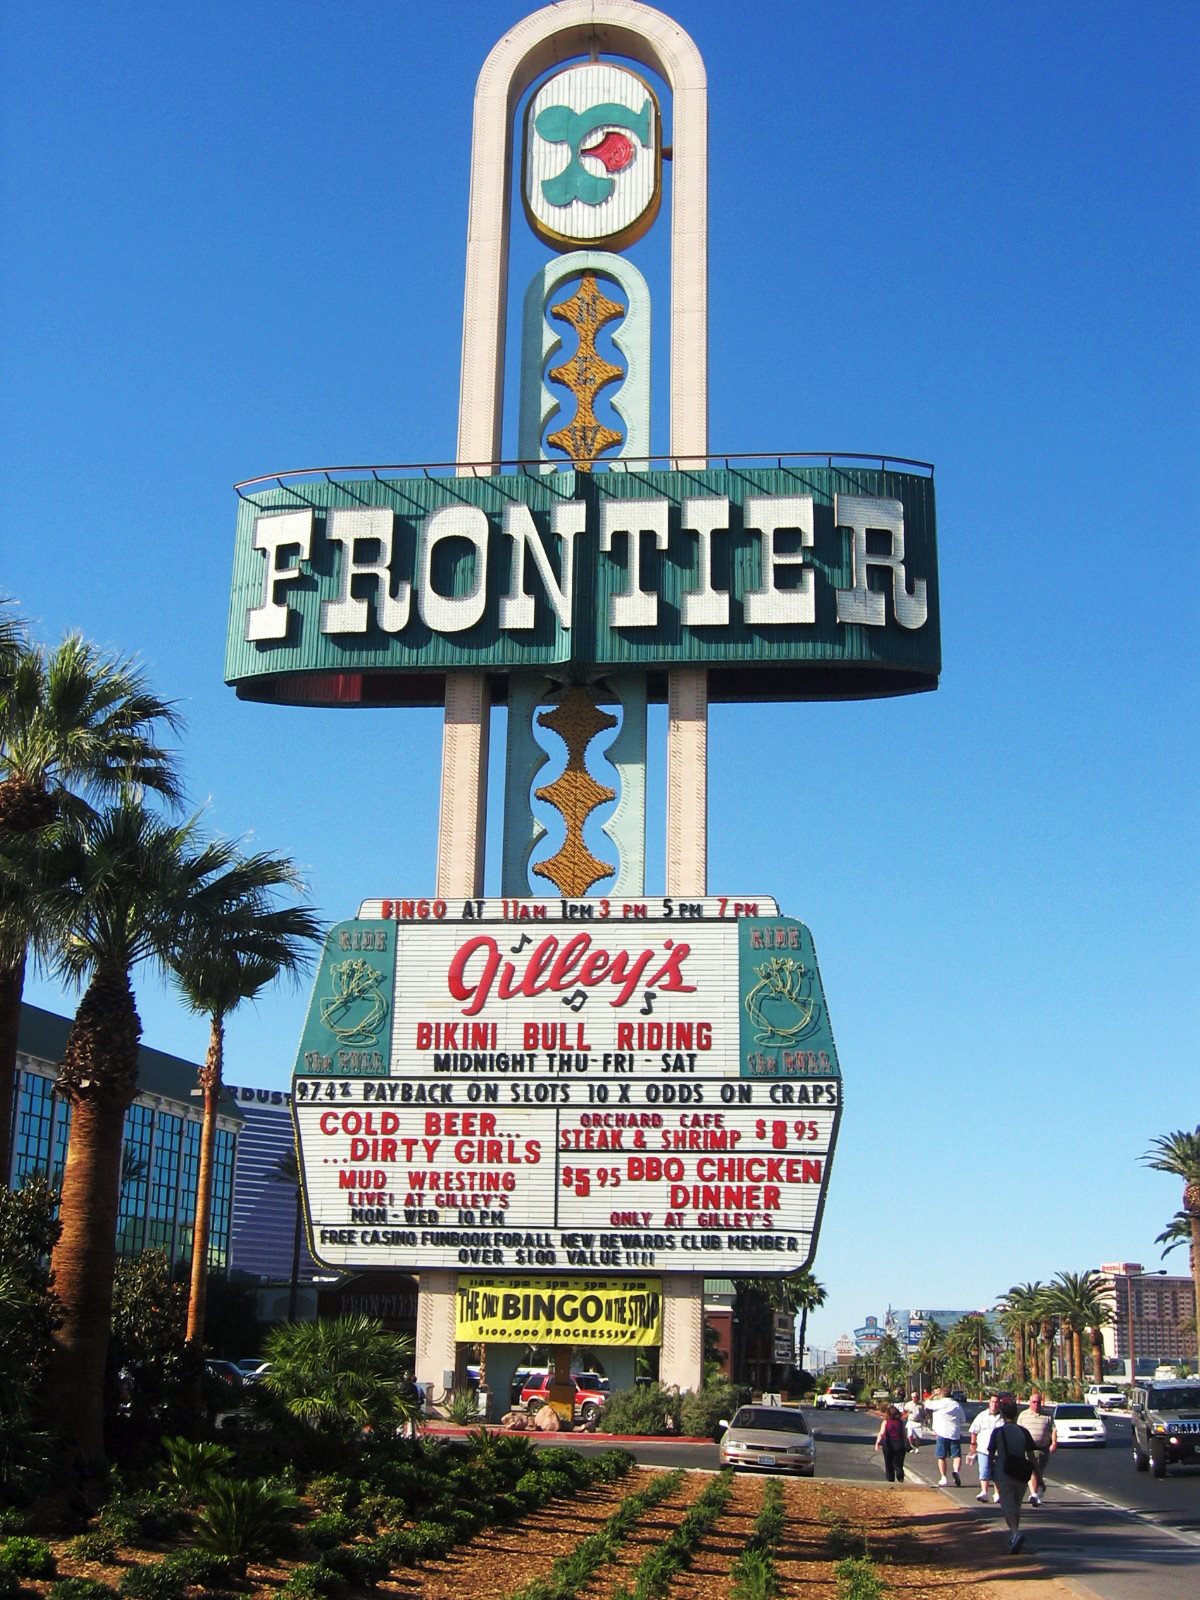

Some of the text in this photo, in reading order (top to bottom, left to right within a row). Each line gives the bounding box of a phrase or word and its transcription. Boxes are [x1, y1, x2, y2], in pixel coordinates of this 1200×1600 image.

[244, 492, 928, 642] FRONTIER
[381, 899, 447, 919] BINGO
[462, 900, 486, 919] AT
[751, 926, 802, 950] RIDE
[447, 932, 698, 1016] Gilley's
[416, 1022, 712, 1051] BIKINI BULL RIDING
[433, 1053, 537, 1073] MIDNIGHT
[661, 1053, 698, 1073] SAT
[363, 1082, 454, 1103] PAYBACK
[467, 1082, 499, 1103] ON
[510, 1083, 571, 1103] SLOTS
[588, 1083, 609, 1103] 10
[646, 1083, 705, 1104] ODDS
[720, 1083, 753, 1104] ON
[769, 1084, 837, 1105] CRAPS
[319, 1111, 400, 1136] COLD
[580, 1113, 726, 1129] ORCHARD CAFE
[560, 1129, 742, 1150] STEAK & SHRIMP
[454, 1139, 542, 1165] GIRLS
[338, 1170, 517, 1192] MUD WRESTING
[627, 1156, 822, 1184] BBQ CHICKEN
[404, 1192, 428, 1208] AT
[434, 1193, 511, 1210] GILLEY'S
[670, 1184, 781, 1211] DINNER
[351, 1208, 388, 1224] MON
[404, 1209, 440, 1225] WED
[610, 1211, 774, 1229] ONLY AT GILLEY'S
[320, 1229, 799, 1253] FREE CASINO FUNBOOK FOR ALL NEW REWARDS CLUB MEMBER
[458, 1249, 505, 1265] OVER
[515, 1249, 558, 1265] $100
[457, 1288, 480, 1323] THE
[481, 1292, 500, 1322] ONLY
[502, 1293, 604, 1323] BINGO
[614, 1297, 628, 1324] THE
[628, 1292, 660, 1329] STRIP
[478, 1326, 637, 1339] $100,000 PROGRESSIVE
